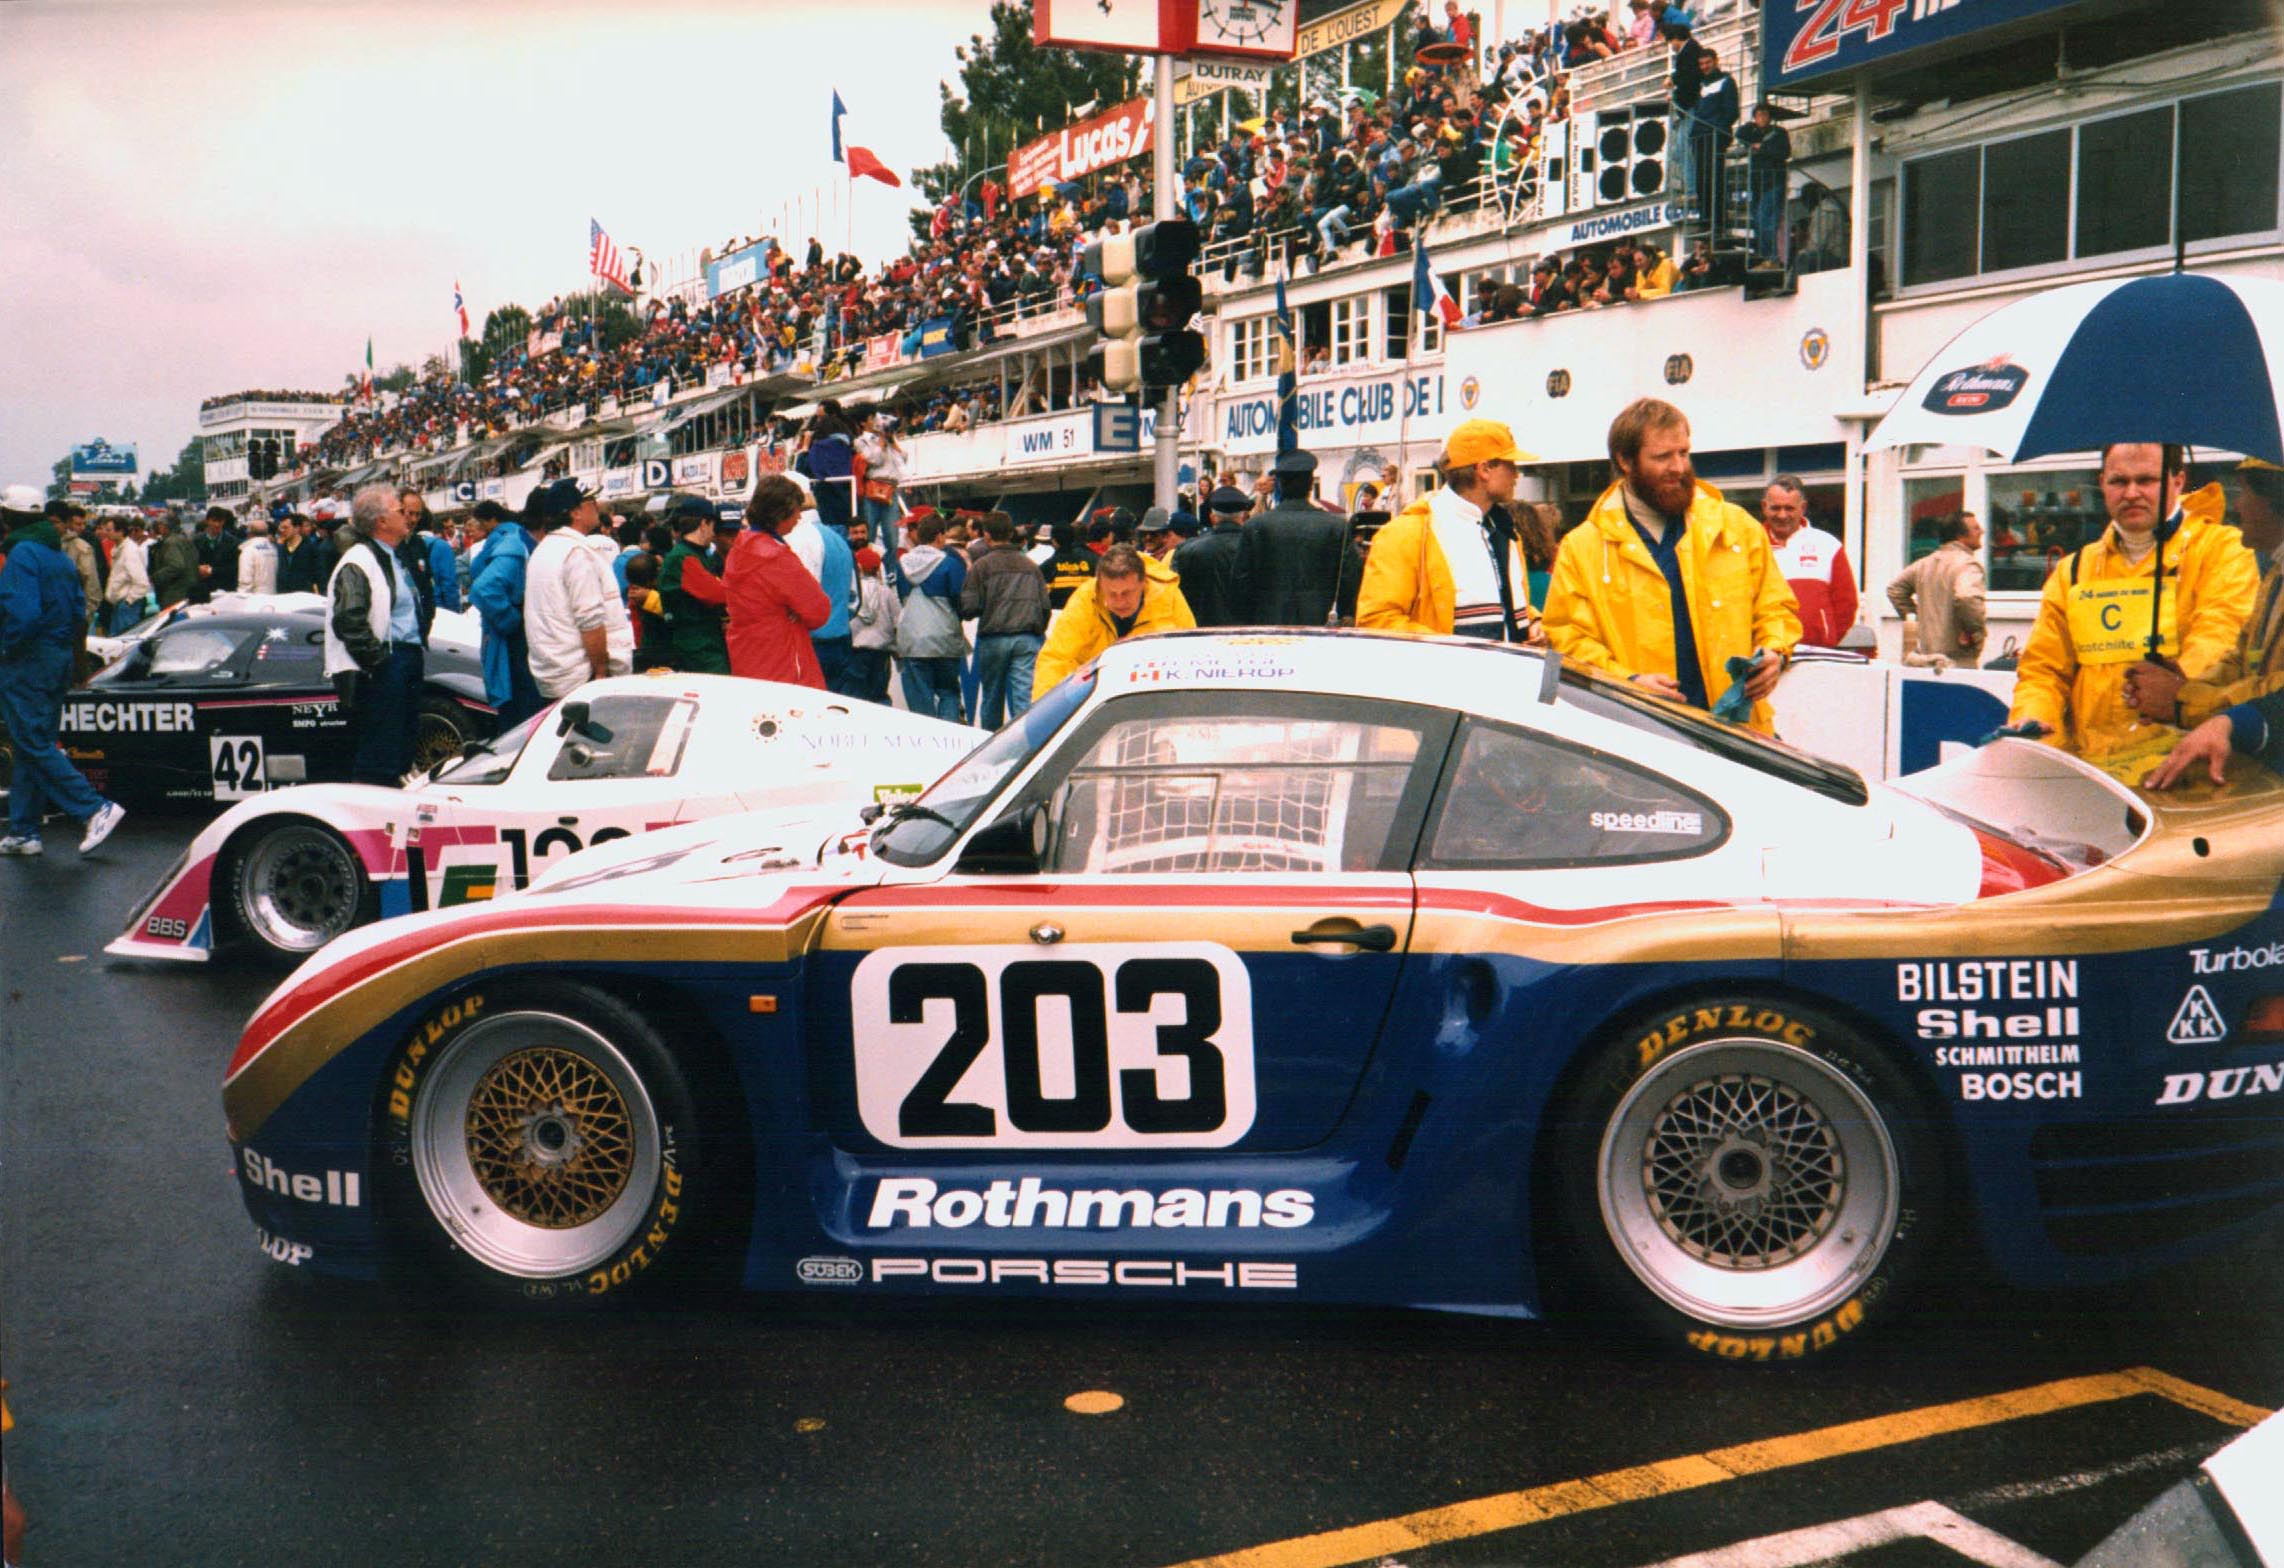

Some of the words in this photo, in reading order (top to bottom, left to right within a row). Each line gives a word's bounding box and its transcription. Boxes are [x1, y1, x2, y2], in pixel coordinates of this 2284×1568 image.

[1301, 31, 1319, 54] DE
[1327, 6, 1381, 43] L'OUEST
[1196, 63, 1266, 82] DUTRAY
[1061, 115, 1131, 178] Lucas
[1571, 205, 1661, 242] AUTOMOBILE
[1341, 382, 1394, 426] CLUB
[1023, 432, 1054, 453] WM
[1063, 428, 1076, 448] 51
[1101, 406, 1134, 447] E
[457, 483, 473, 500] C
[647, 461, 668, 486] D
[2101, 604, 2122, 631] C
[59, 702, 195, 733] HECHTER
[214, 740, 263, 791] 42
[147, 916, 187, 937] BBS
[1897, 960, 2079, 1001] BILSTEIN
[1916, 1007, 2081, 1039] Shell
[389, 993, 484, 1120] DUNLOP
[888, 958, 1227, 1137] 203
[1935, 1045, 2081, 1067] SCHMITTHELM
[1961, 1071, 2082, 1101] BOSCH
[243, 1147, 360, 1208] Shell
[868, 1177, 1316, 1228] Rothmans
[871, 1258, 1298, 1289] PORSCHE
[1687, 1299, 1864, 1361] DUNLOP
